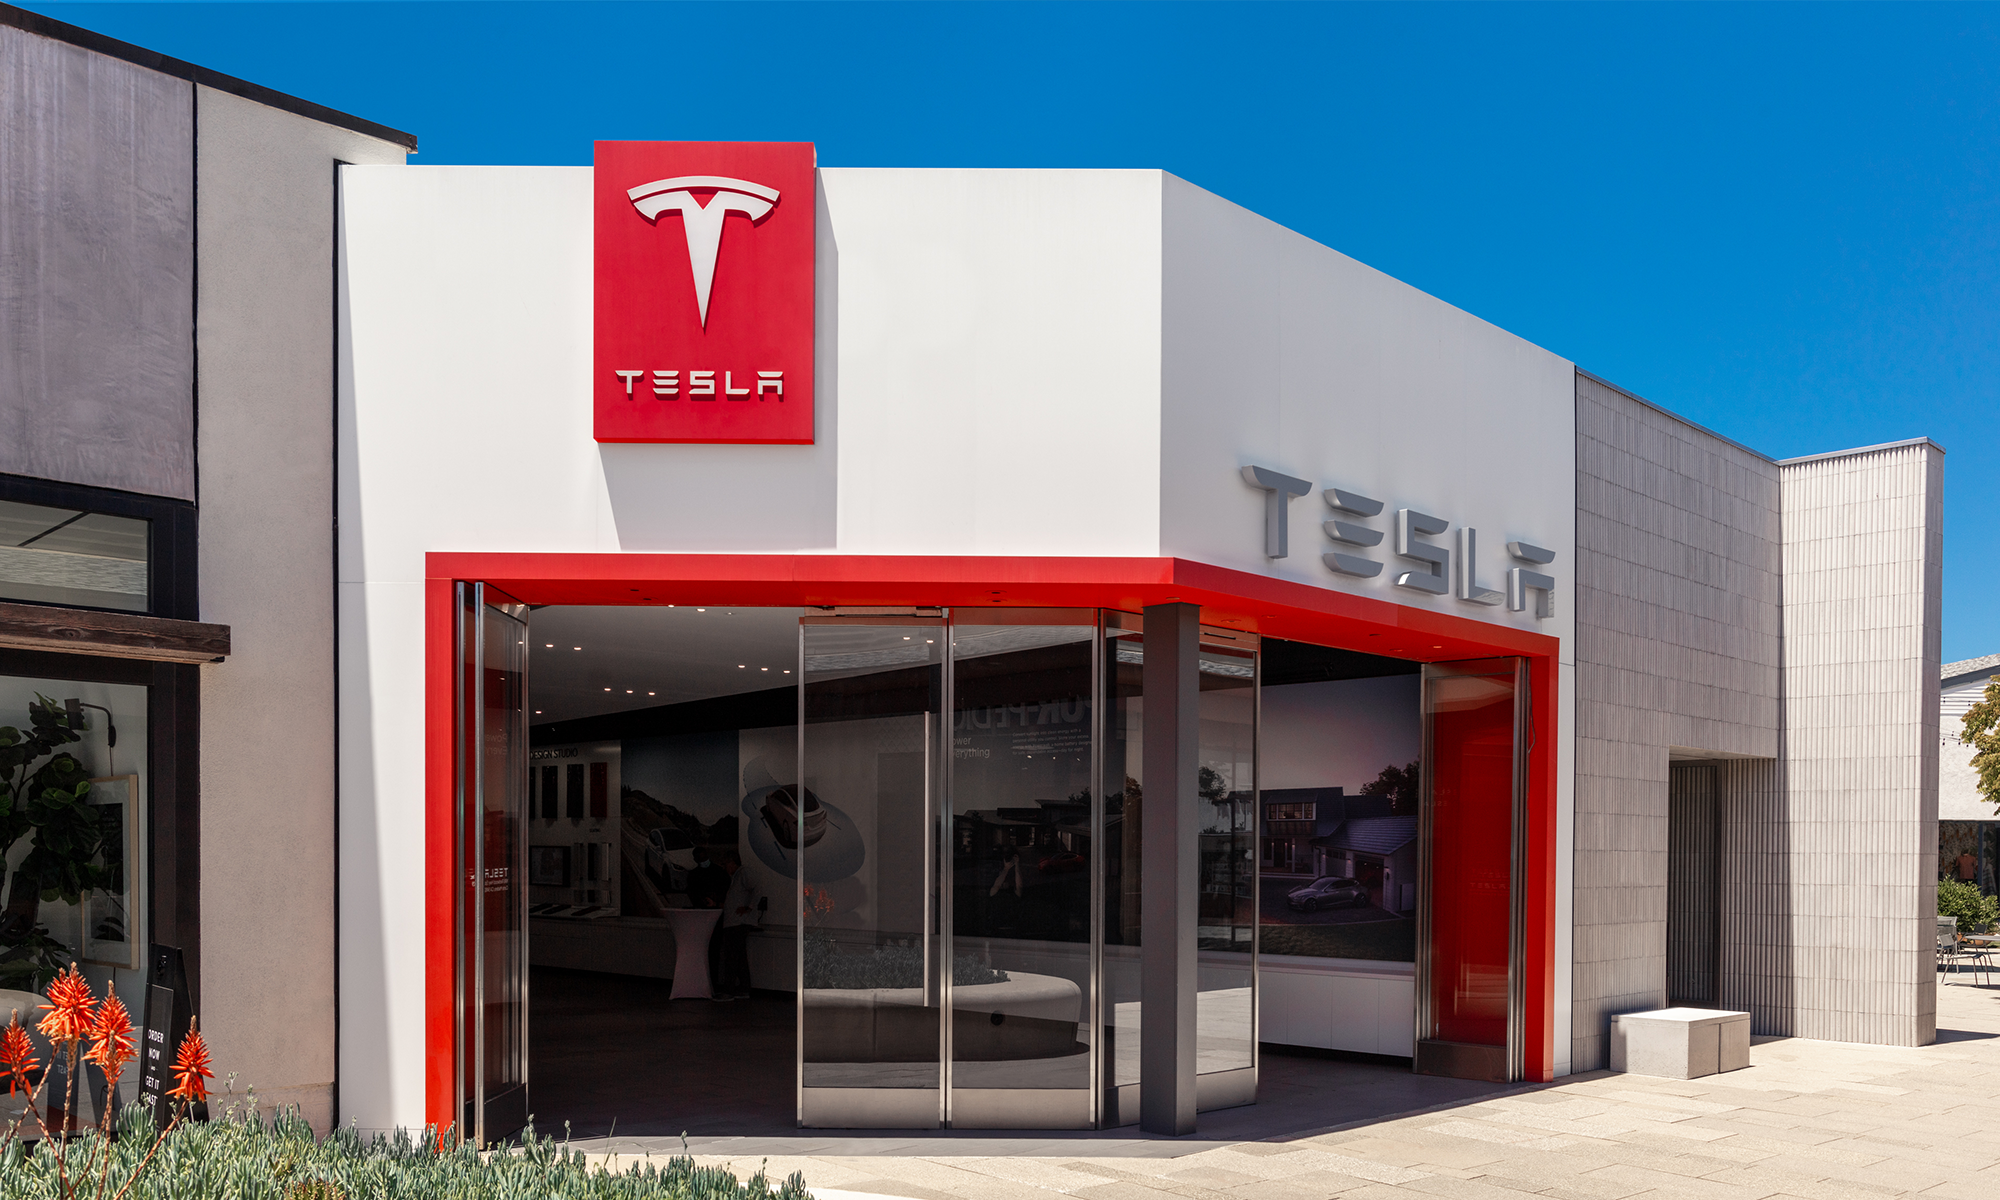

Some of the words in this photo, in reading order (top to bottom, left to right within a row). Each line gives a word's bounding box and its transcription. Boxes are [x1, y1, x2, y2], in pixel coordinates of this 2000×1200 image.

[615, 370, 784, 395] TESLA
[1241, 465, 1556, 619] TESLA
[953, 737, 972, 746] ower
[530, 749, 552, 760] DESIGN
[554, 747, 578, 759] STUDIO
[954, 747, 990, 760] erything
[147, 1029, 164, 1044] ORDER
[148, 1047, 161, 1061] NOW
[145, 1075, 154, 1088] GET
[154, 1079, 160, 1091] IT
